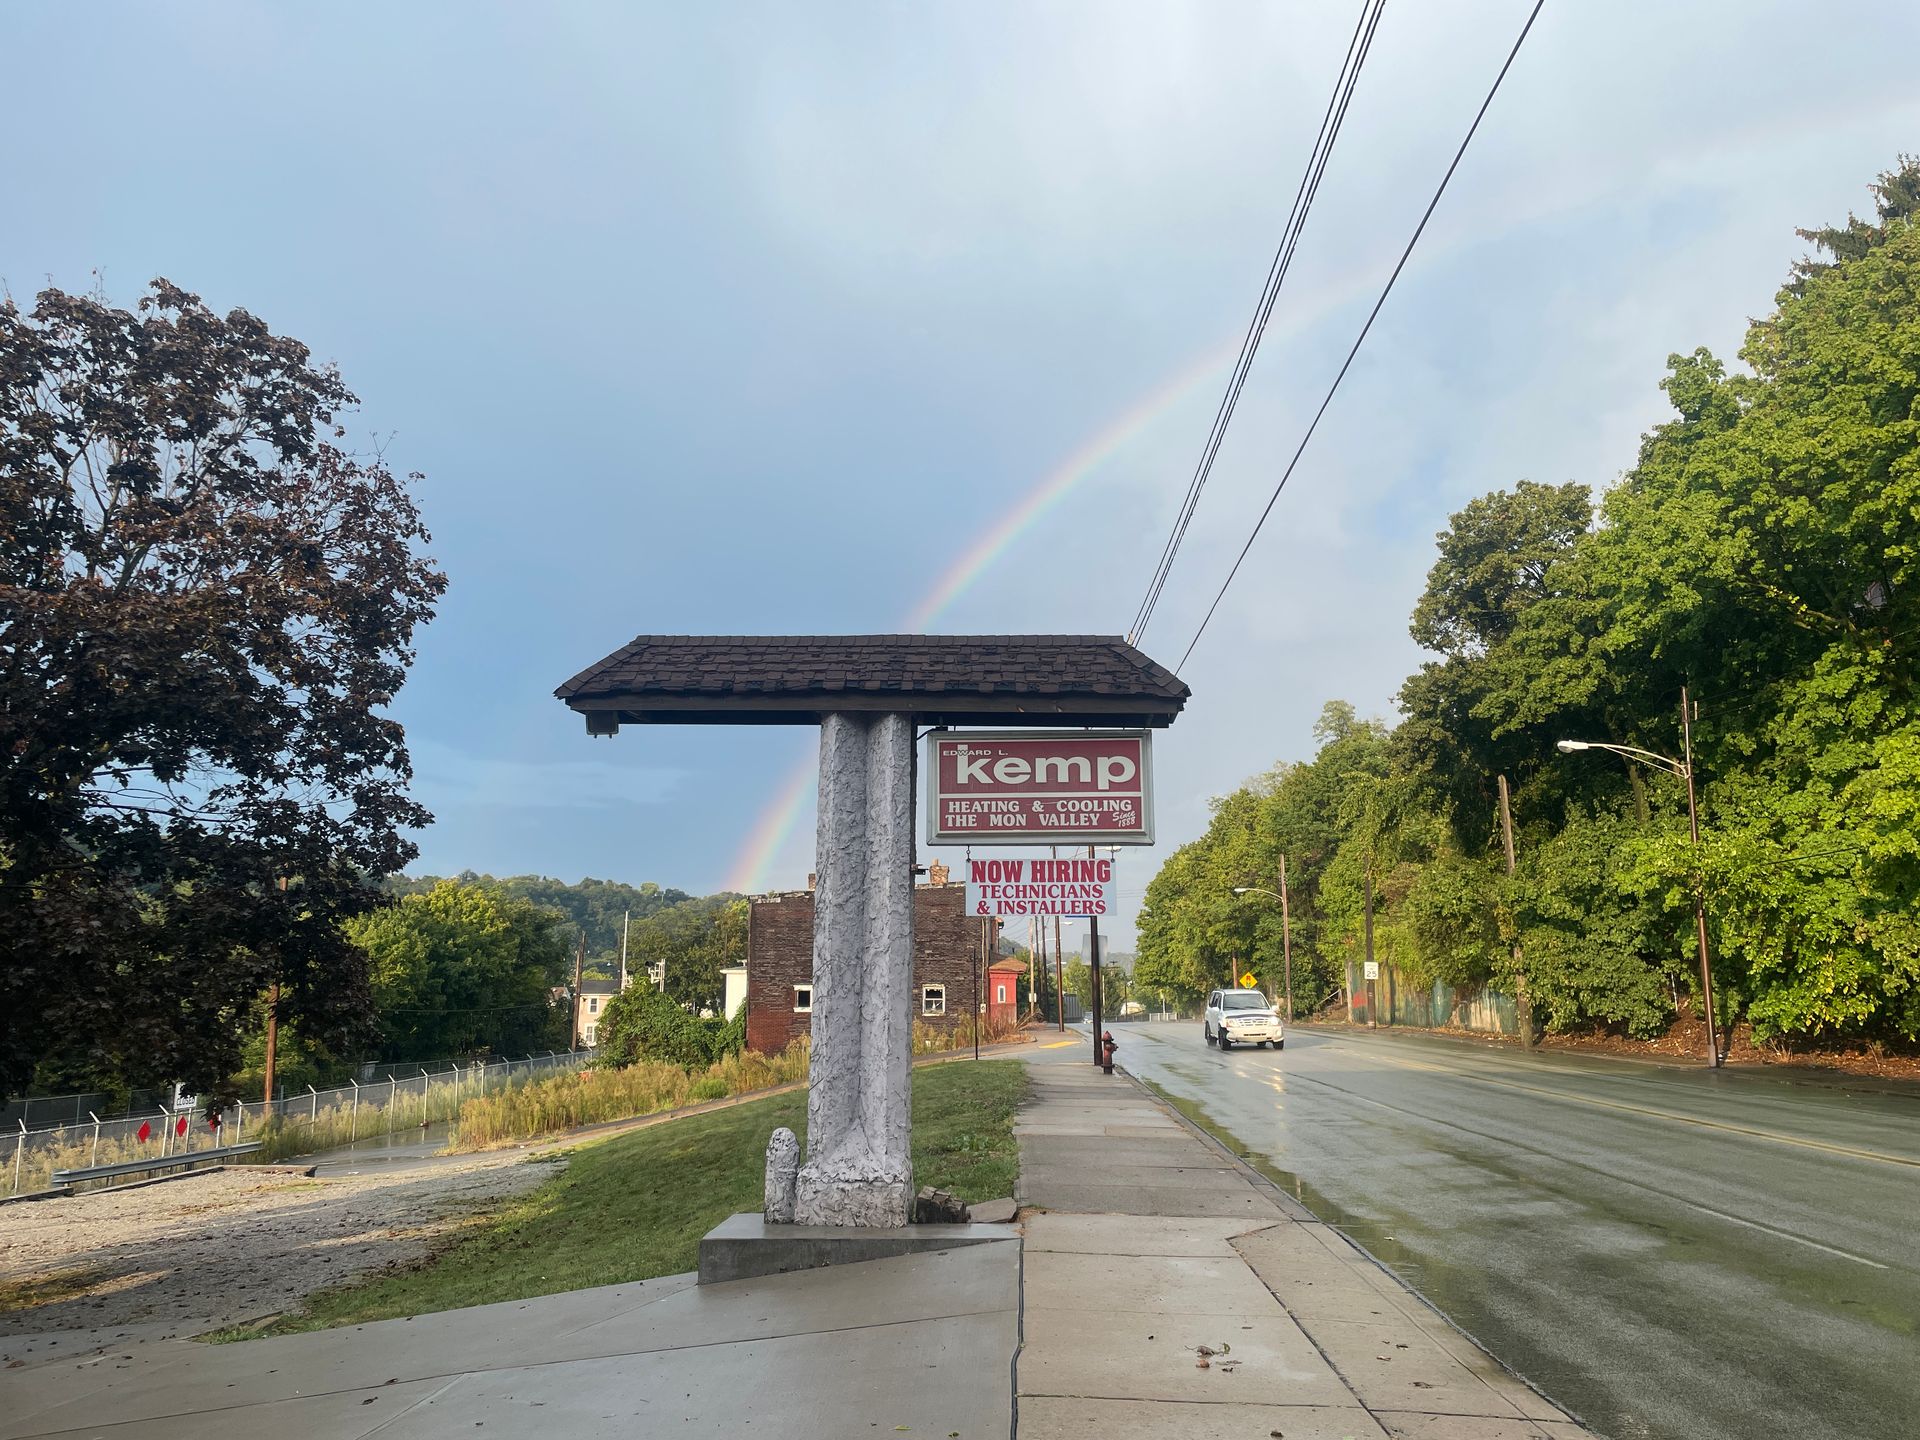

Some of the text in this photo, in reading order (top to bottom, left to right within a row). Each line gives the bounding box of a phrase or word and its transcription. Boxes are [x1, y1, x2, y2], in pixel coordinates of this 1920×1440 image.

[957, 744, 1136, 790] kemp
[948, 800, 1132, 813] HEATING & COOLING
[945, 813, 1100, 827] THE MON VALLEY
[1112, 811, 1136, 822] Since
[971, 860, 1111, 883] NOW HIRING
[979, 884, 1103, 898] TECHNICIANS
[976, 900, 1106, 915] & INSTALLERS
